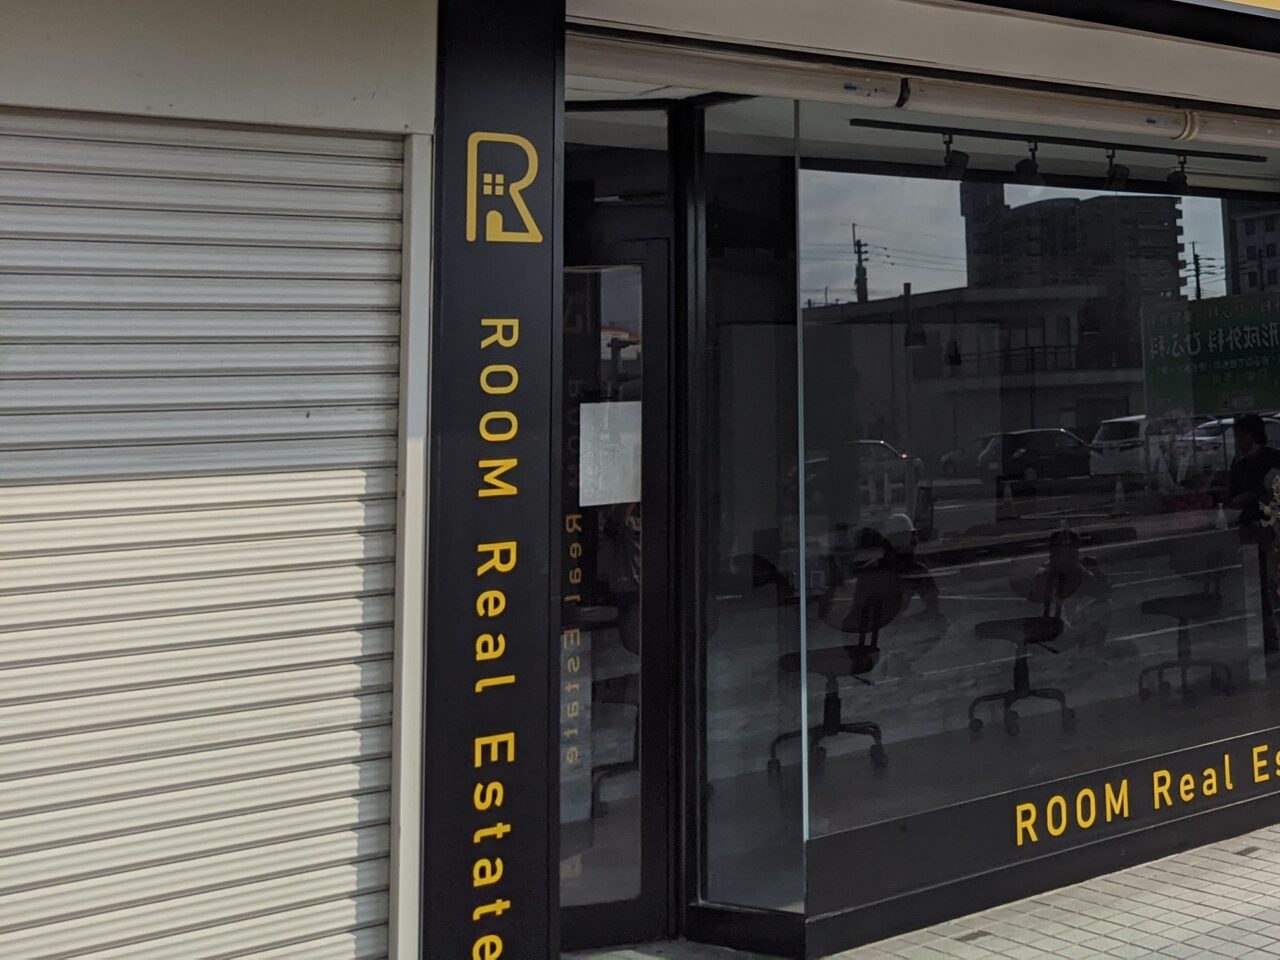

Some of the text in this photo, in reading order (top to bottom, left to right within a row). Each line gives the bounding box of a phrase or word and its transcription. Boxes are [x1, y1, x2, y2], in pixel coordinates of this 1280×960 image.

[472, 317, 520, 960] ROOM Real Estate
[1015, 778, 1130, 846] ROOM
[1152, 753, 1233, 810] Real
